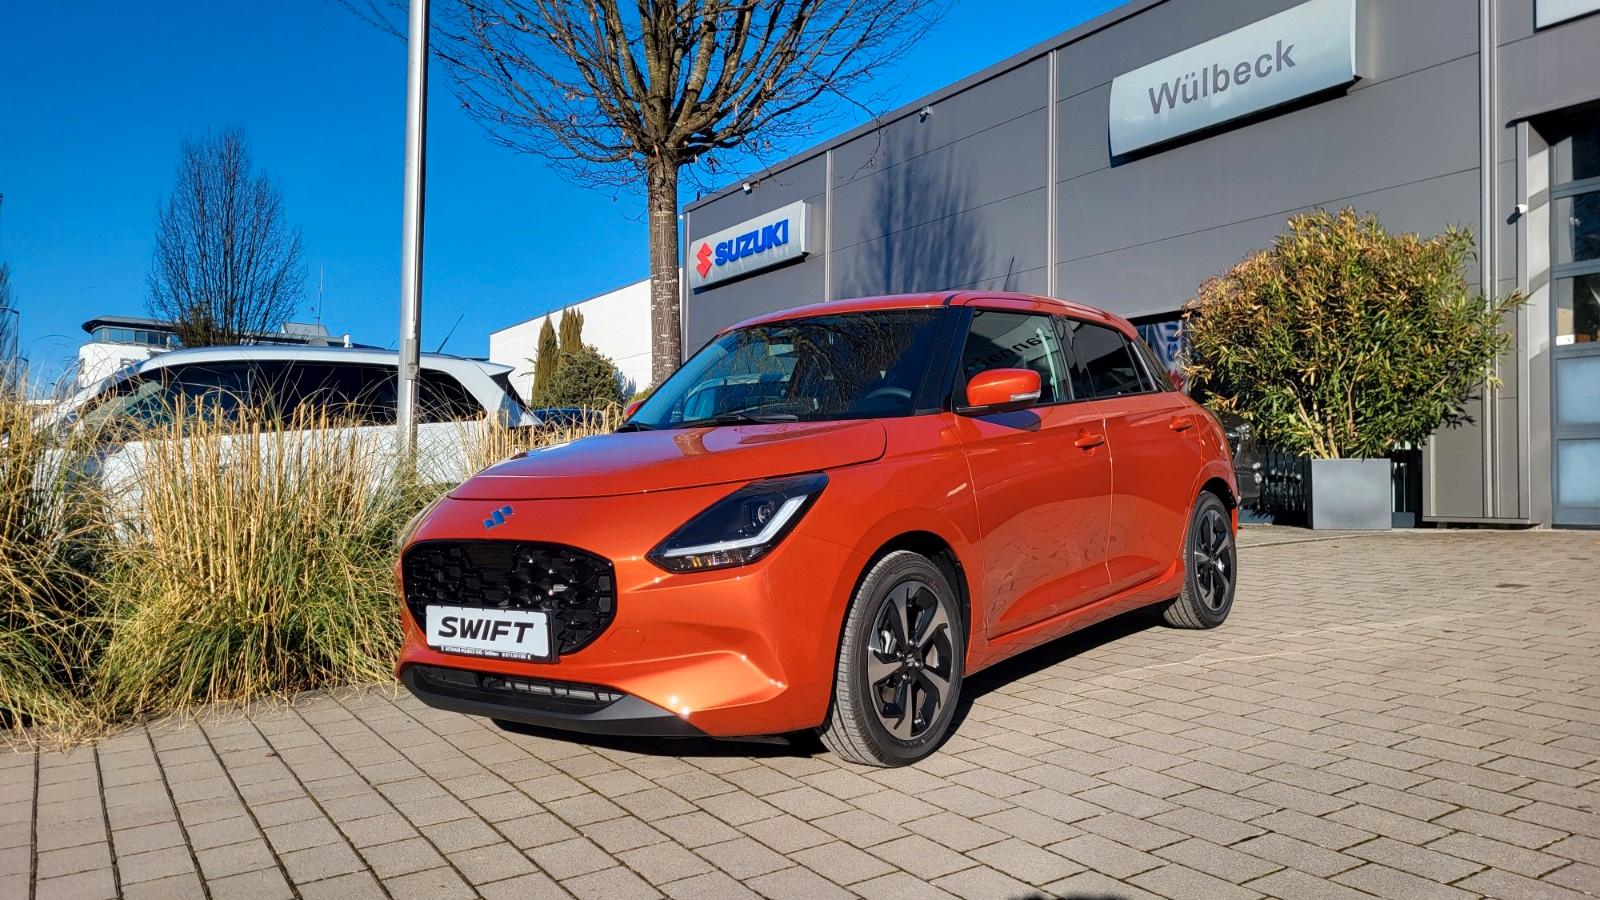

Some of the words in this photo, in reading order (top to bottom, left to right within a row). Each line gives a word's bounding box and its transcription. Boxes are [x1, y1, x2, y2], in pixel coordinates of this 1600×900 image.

[1148, 40, 1296, 114] Wülbeck
[715, 218, 789, 267] SUZUKI
[438, 616, 534, 643] SWIFT
